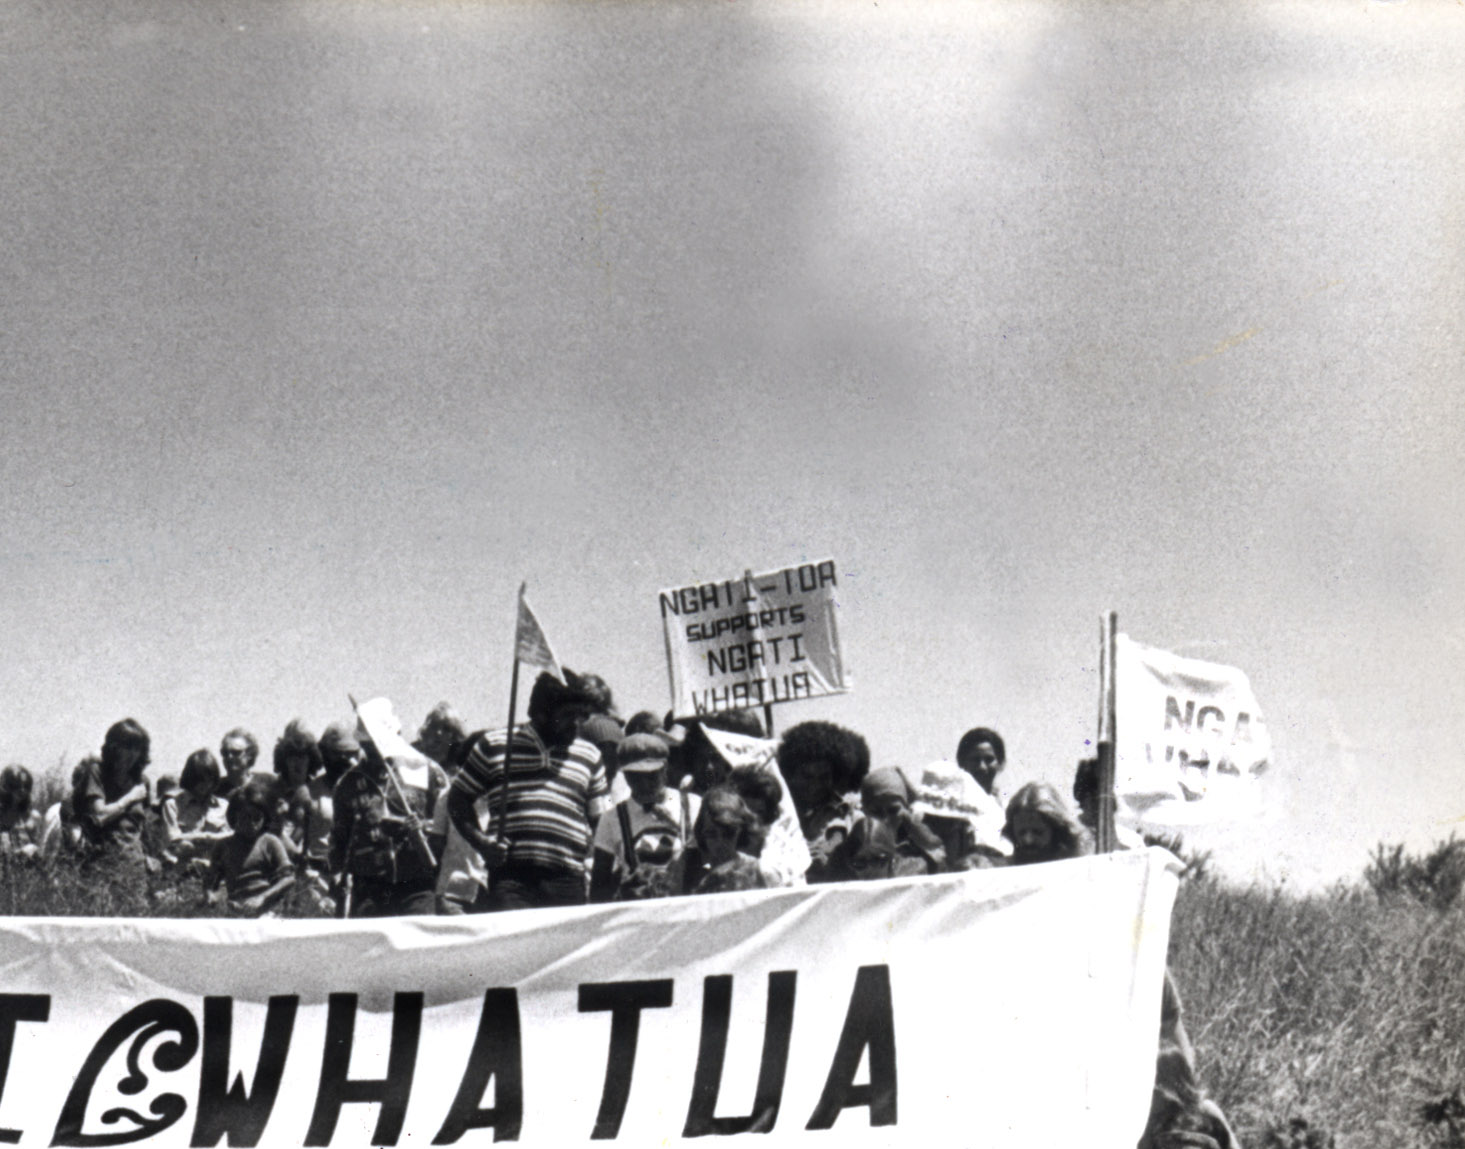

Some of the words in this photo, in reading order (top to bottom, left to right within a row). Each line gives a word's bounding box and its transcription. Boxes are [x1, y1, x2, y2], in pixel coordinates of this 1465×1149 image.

[658, 559, 837, 618] NGATI-TOA
[686, 604, 806, 642] SUPPORTS
[706, 633, 806, 676] NGATI
[692, 671, 811, 716] WHATUA
[189, 963, 899, 1149] WHATUA
